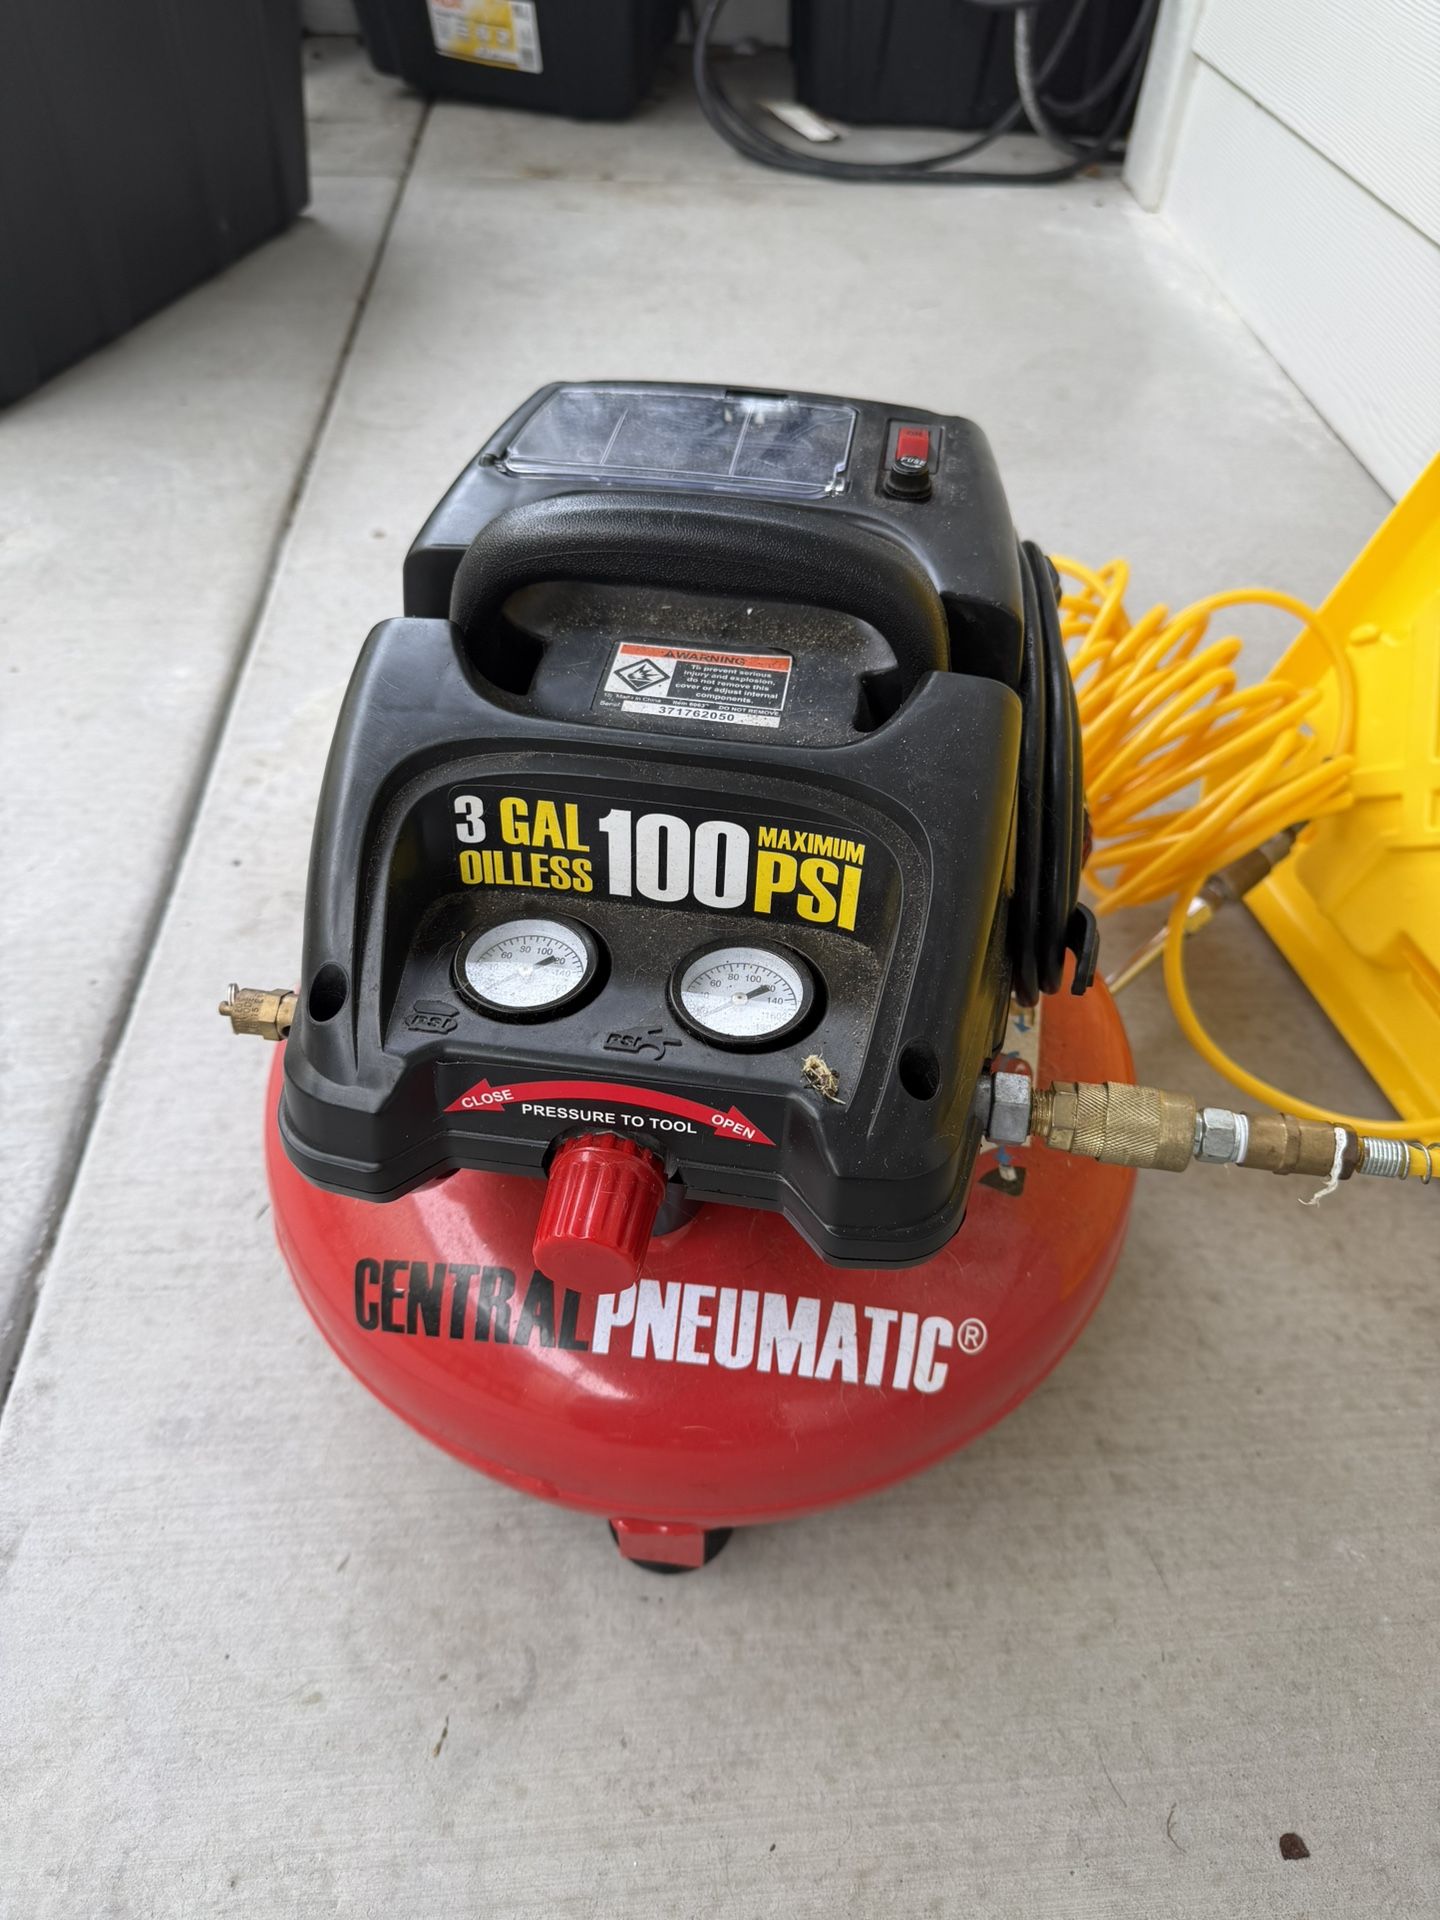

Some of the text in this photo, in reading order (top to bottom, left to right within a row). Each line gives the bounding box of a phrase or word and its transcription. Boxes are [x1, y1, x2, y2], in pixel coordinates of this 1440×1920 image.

[901, 456, 927, 466] FUSE
[675, 650, 746, 666] WARNING
[703, 666, 738, 675] prevent
[739, 670, 772, 678] serious
[714, 687, 742, 695] adjust
[743, 690, 779, 699] internal
[717, 681, 751, 690] remove
[752, 684, 770, 692] this
[695, 692, 755, 704] components.
[658, 706, 735, 721] 371762050
[748, 708, 781, 716] REMOVE
[454, 795, 590, 852] 3 GAL
[758, 826, 866, 865] MAXIMUM
[598, 808, 750, 909] 100
[459, 850, 593, 892] OILLESS
[754, 850, 862, 931] PSI
[537, 947, 553, 956] 100
[709, 973, 784, 1005] 60 80 100 140
[461, 1088, 515, 1109] CLOSE
[521, 1103, 698, 1134] PRESSURE TO TOOL
[711, 1113, 756, 1139] OPEN
